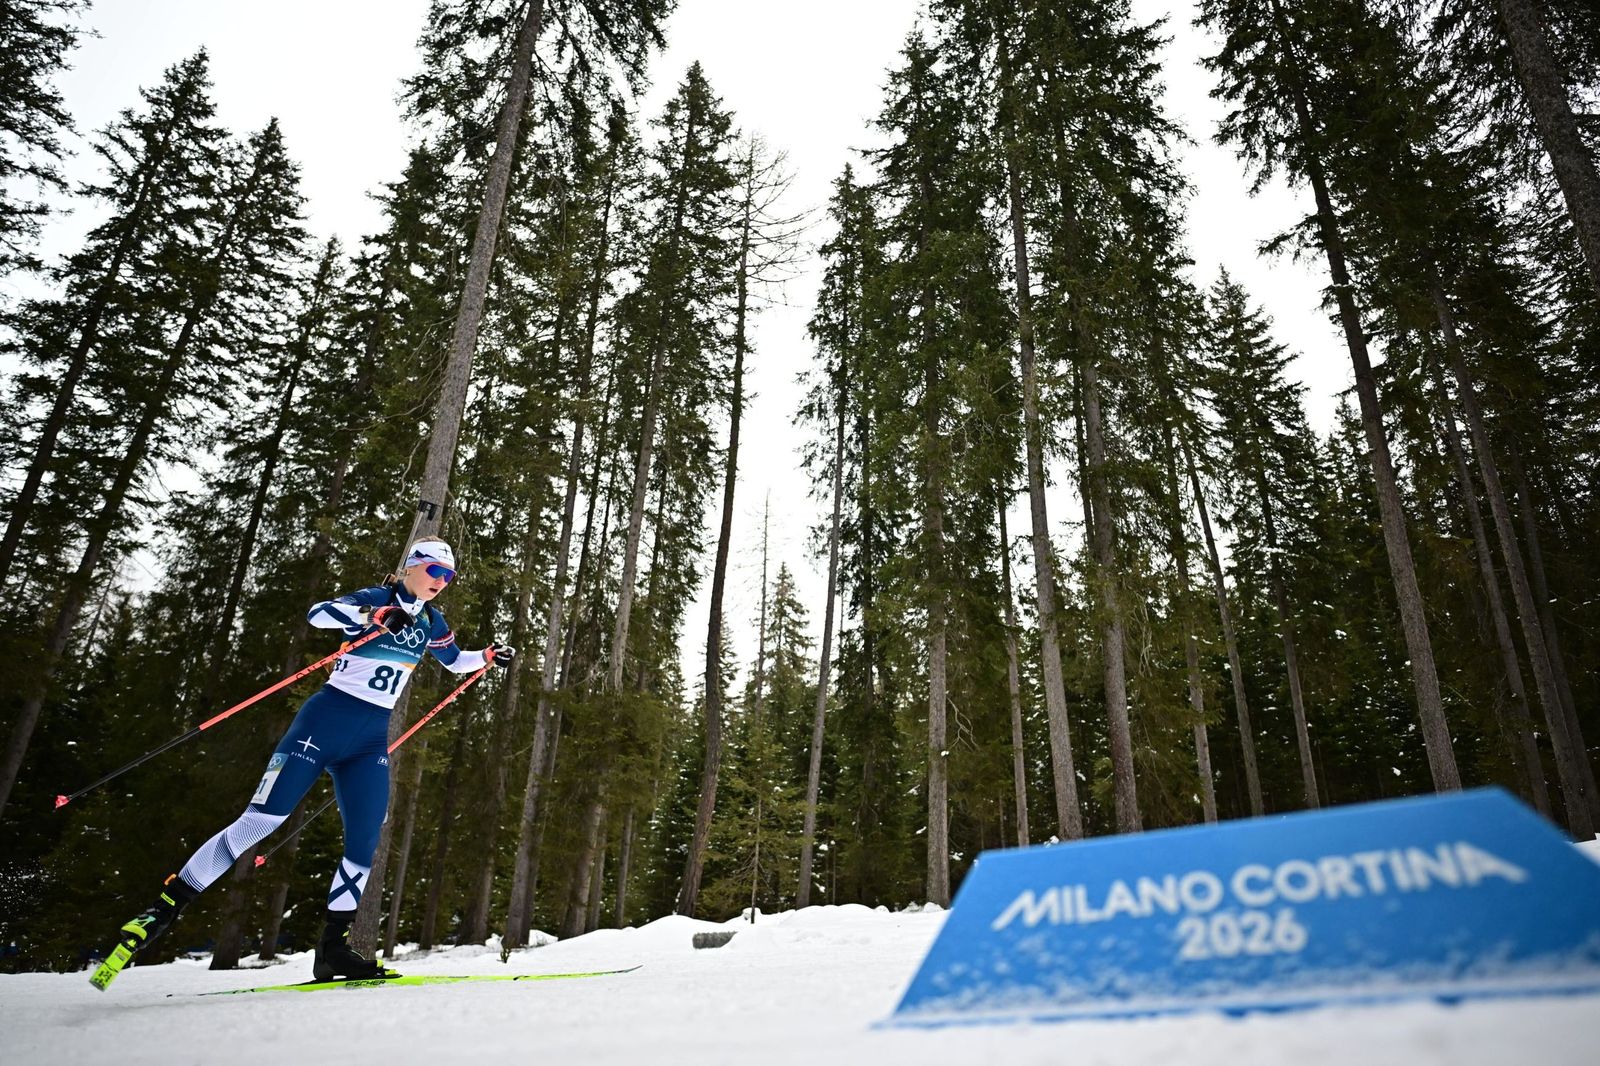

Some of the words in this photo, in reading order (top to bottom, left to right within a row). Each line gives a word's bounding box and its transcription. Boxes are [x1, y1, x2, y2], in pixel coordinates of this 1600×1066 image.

[368, 664, 404, 696] 81
[991, 868, 1222, 931] MILANO
[1231, 841, 1528, 906] CORTINA
[1176, 908, 1308, 961] 2026
